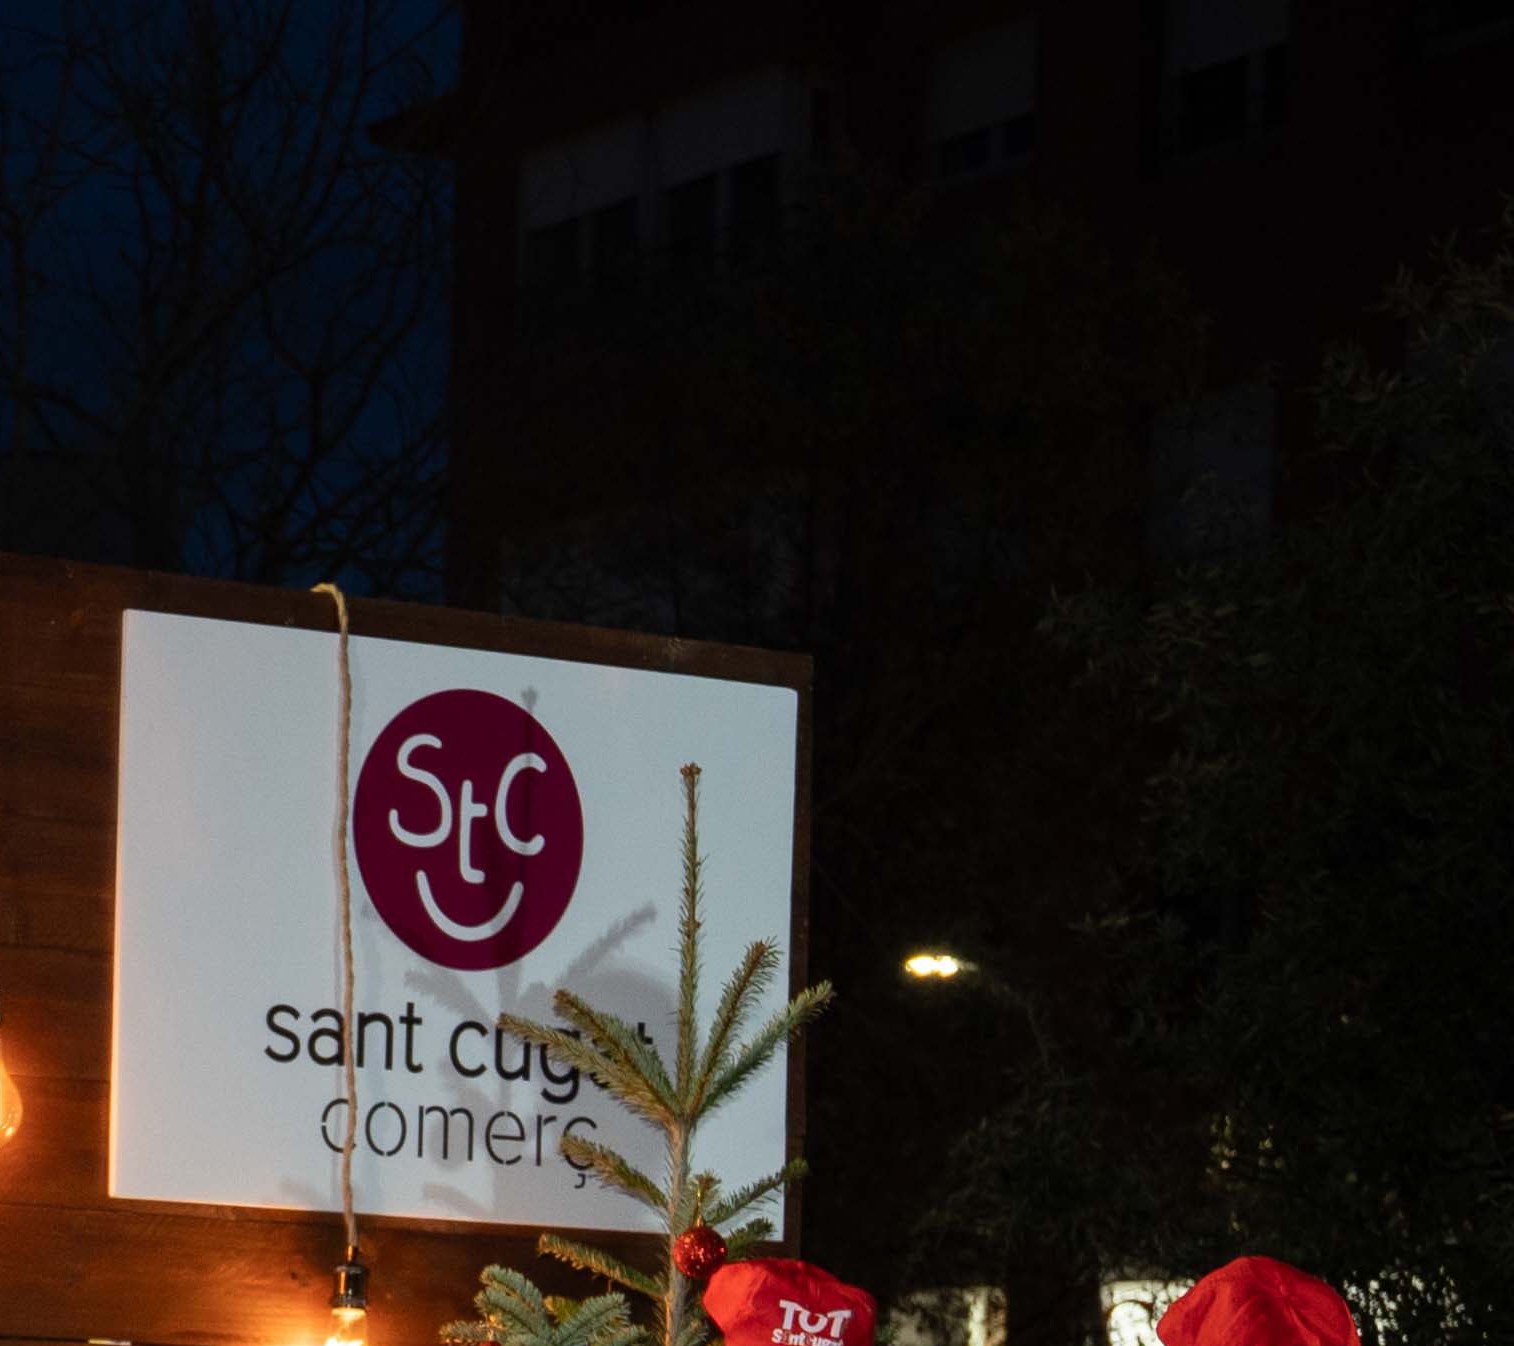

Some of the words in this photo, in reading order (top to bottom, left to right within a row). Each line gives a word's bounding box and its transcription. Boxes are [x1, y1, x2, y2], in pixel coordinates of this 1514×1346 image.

[264, 1002, 423, 1074] sant
[449, 1017, 654, 1104] cug
[320, 1098, 597, 1189] comerç
[779, 1299, 852, 1338] TOT
